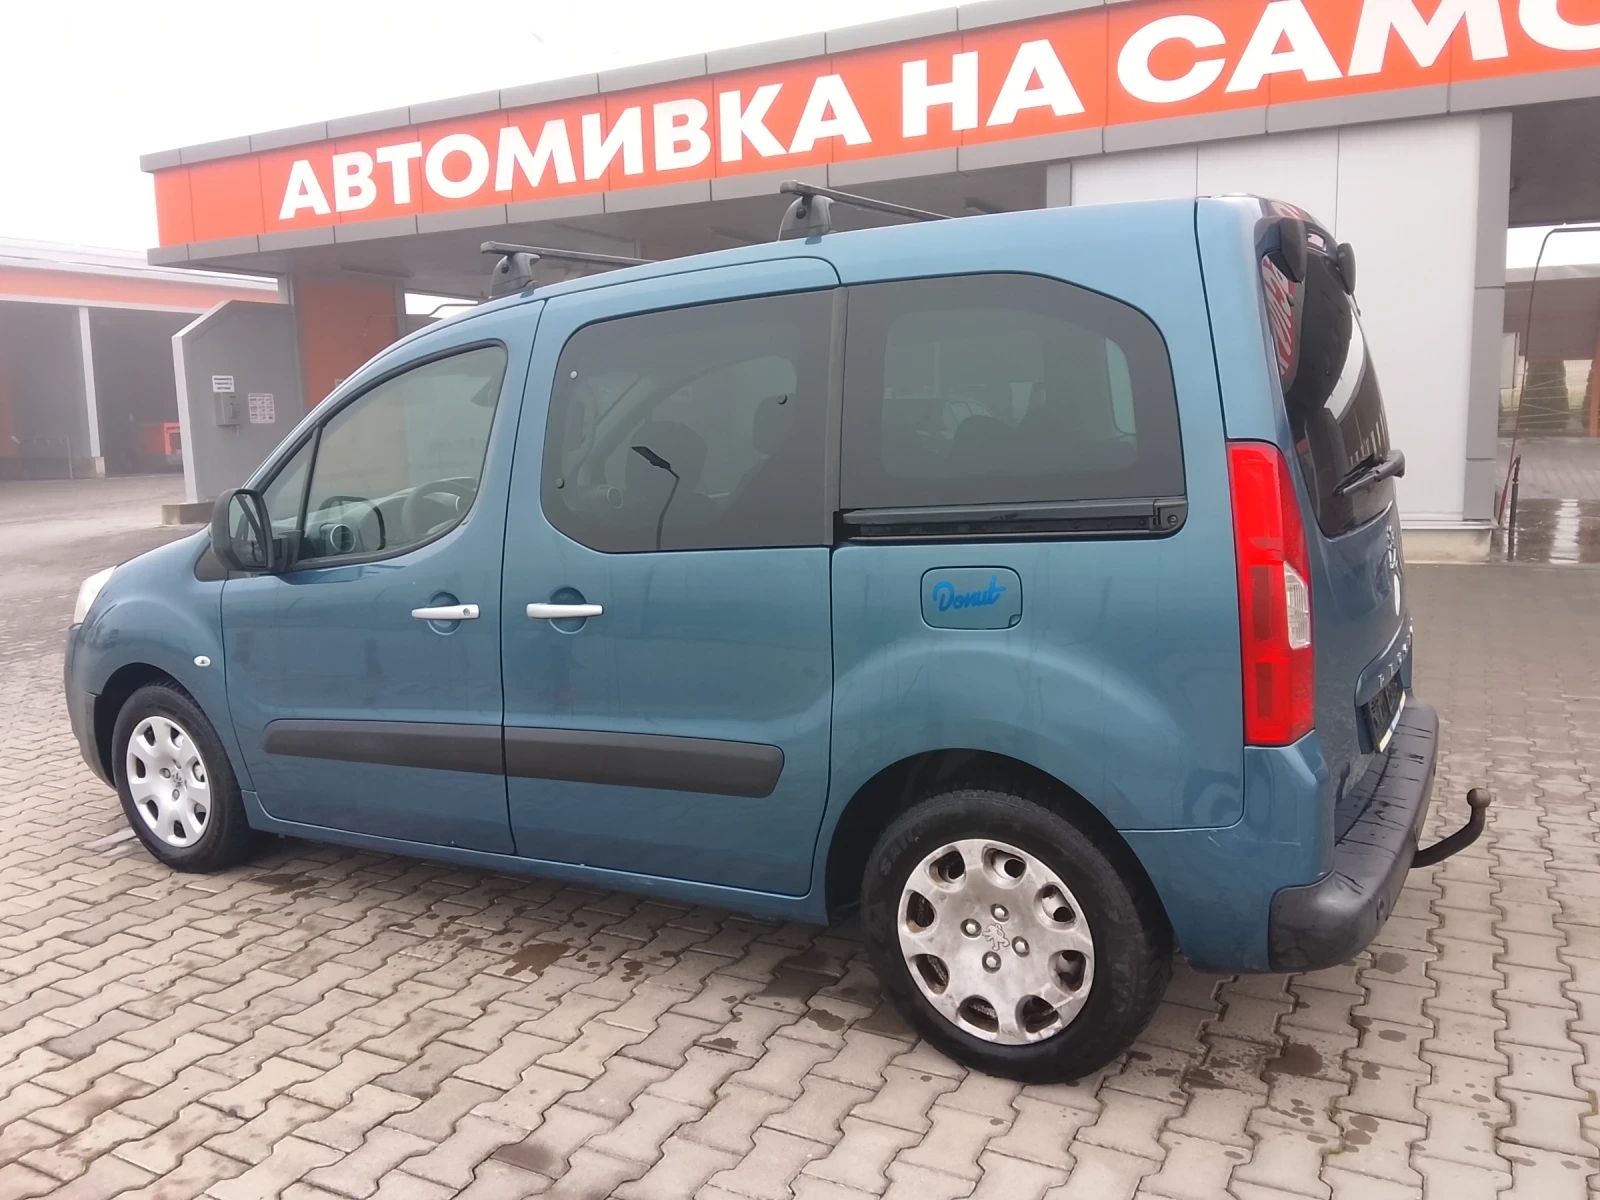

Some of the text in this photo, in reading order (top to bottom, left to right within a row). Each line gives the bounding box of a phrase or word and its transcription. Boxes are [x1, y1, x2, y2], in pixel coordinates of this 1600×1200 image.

[278, 73, 873, 220] АВТОМИВКА
[901, 39, 1086, 139] НА
[932, 575, 1007, 612] Donut
